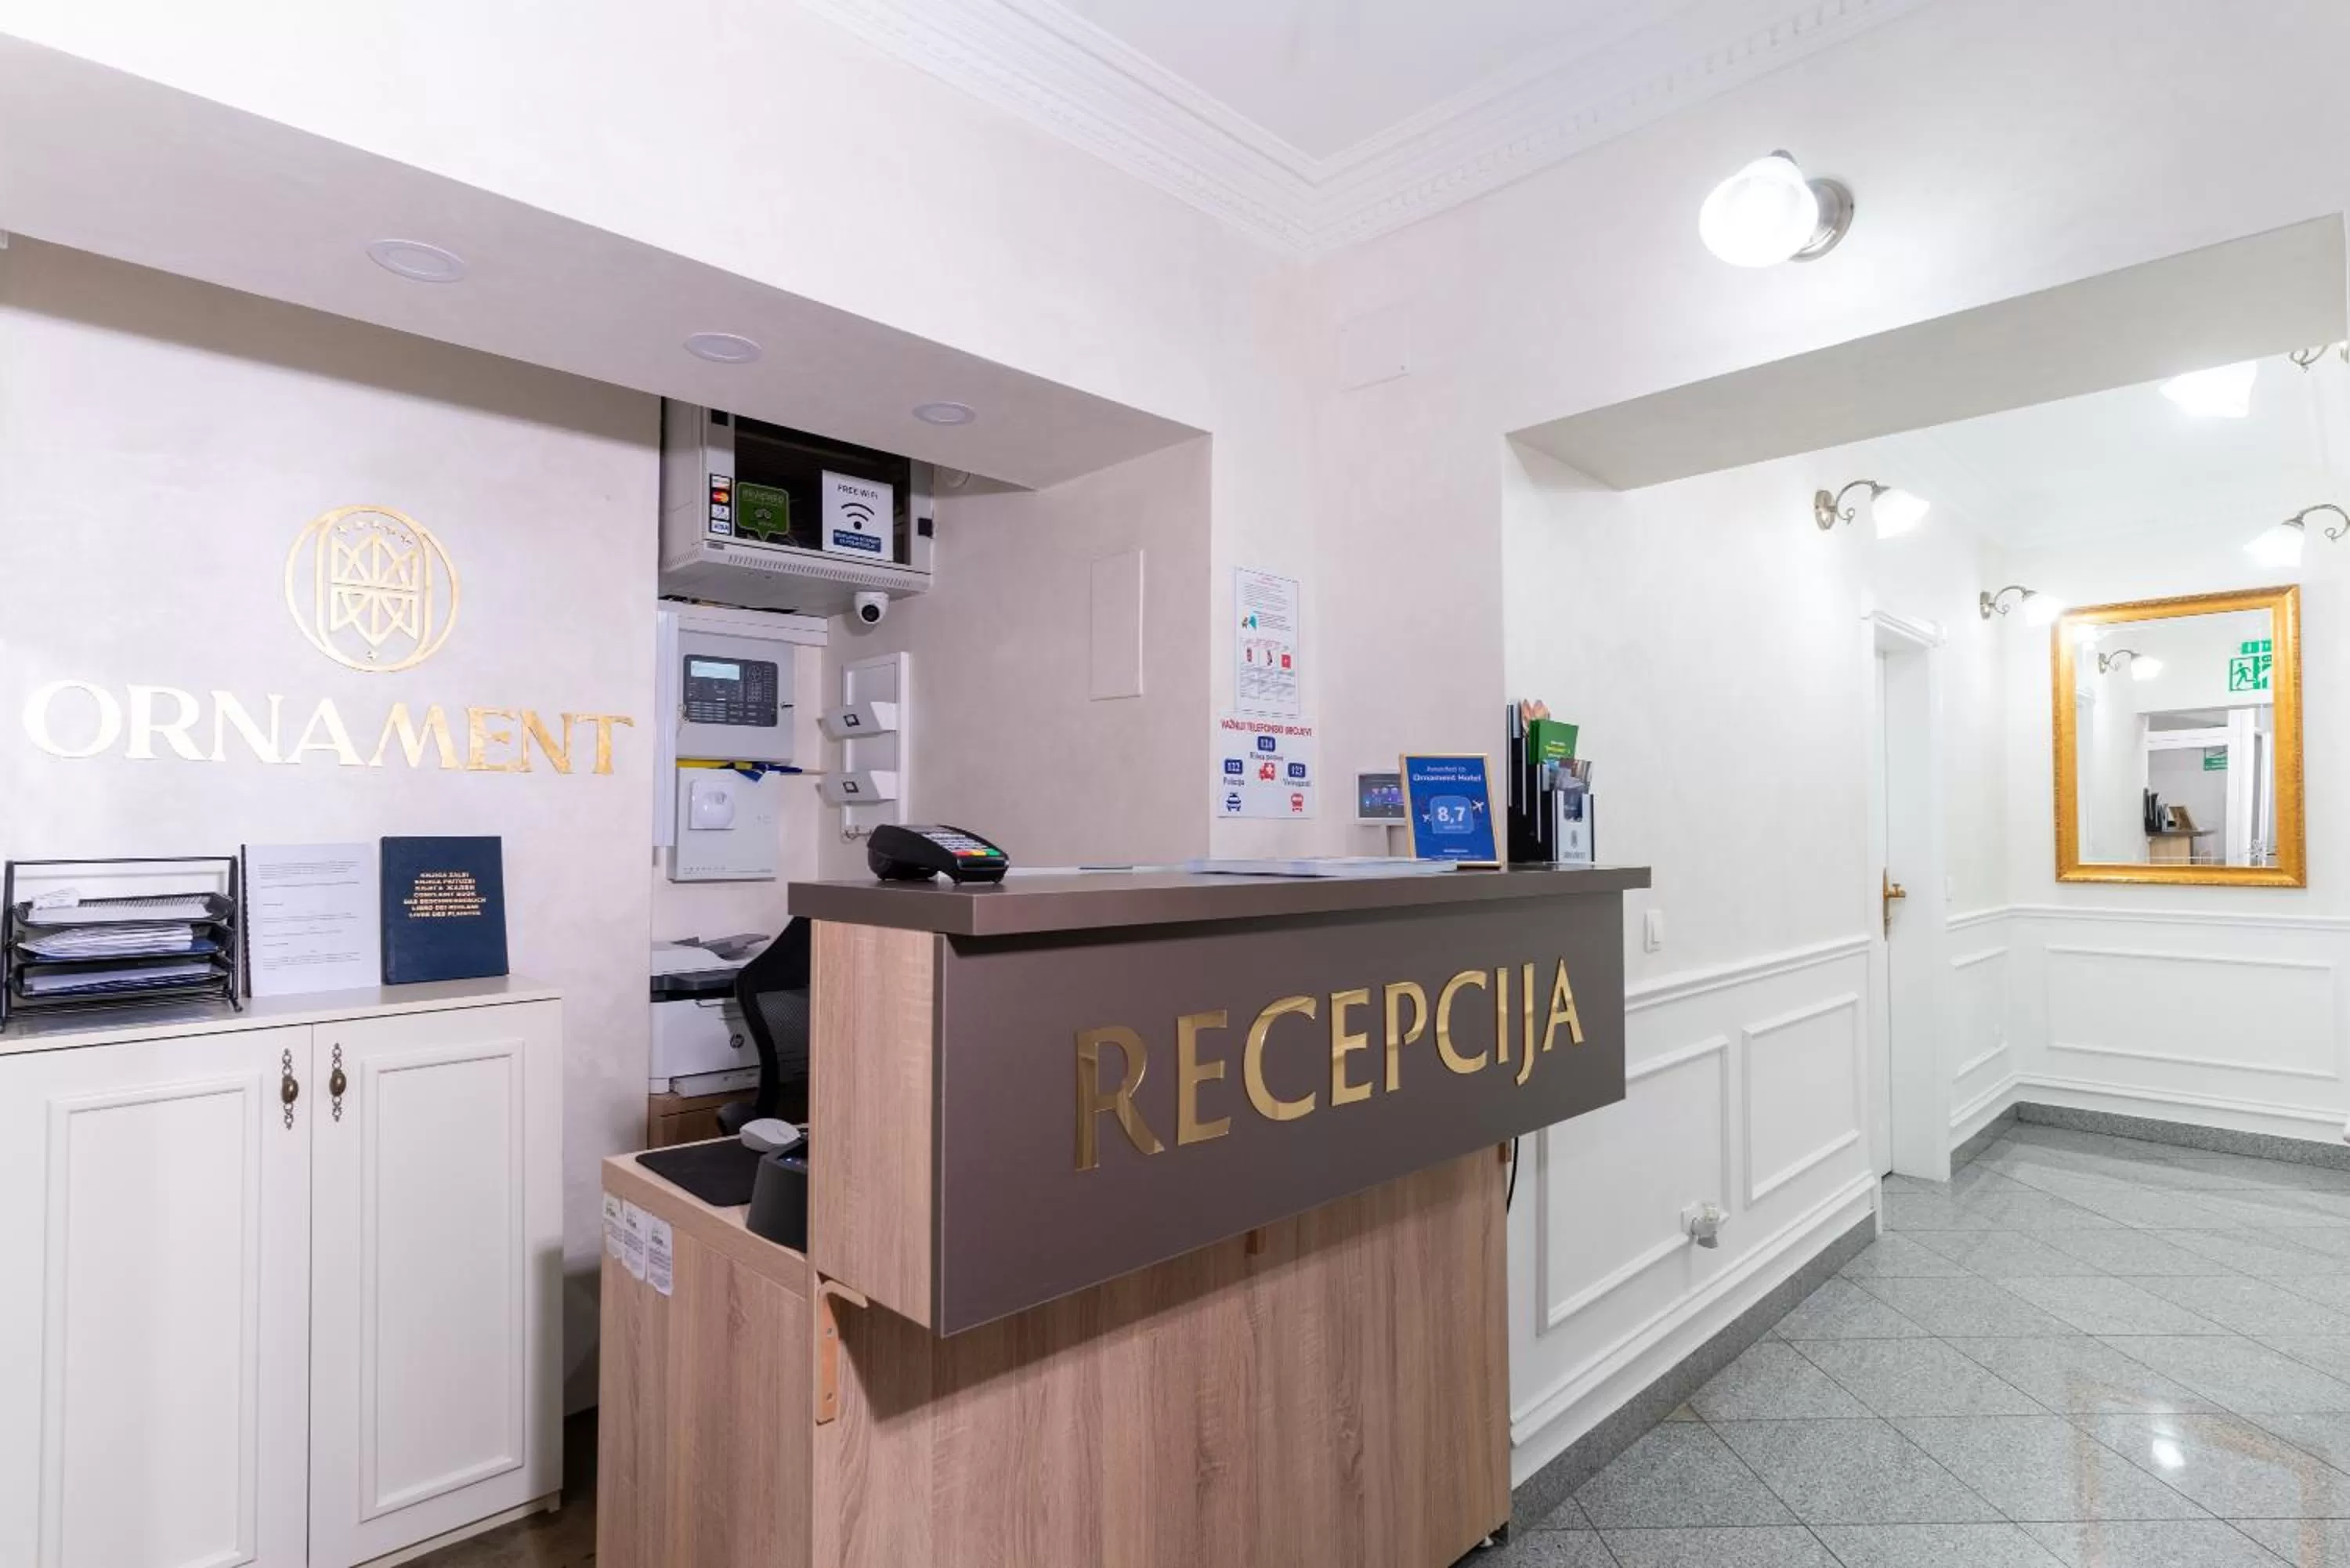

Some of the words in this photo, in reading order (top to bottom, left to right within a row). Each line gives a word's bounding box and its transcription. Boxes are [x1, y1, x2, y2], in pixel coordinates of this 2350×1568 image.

[837, 484, 859, 496] FREE
[22, 679, 634, 775] ORNAMENT
[1412, 773, 1456, 782] Ornament
[1458, 773, 1482, 782] Hotel
[1437, 805, 1466, 824] 8,7
[1075, 957, 1585, 1172] RECEPCIJA
